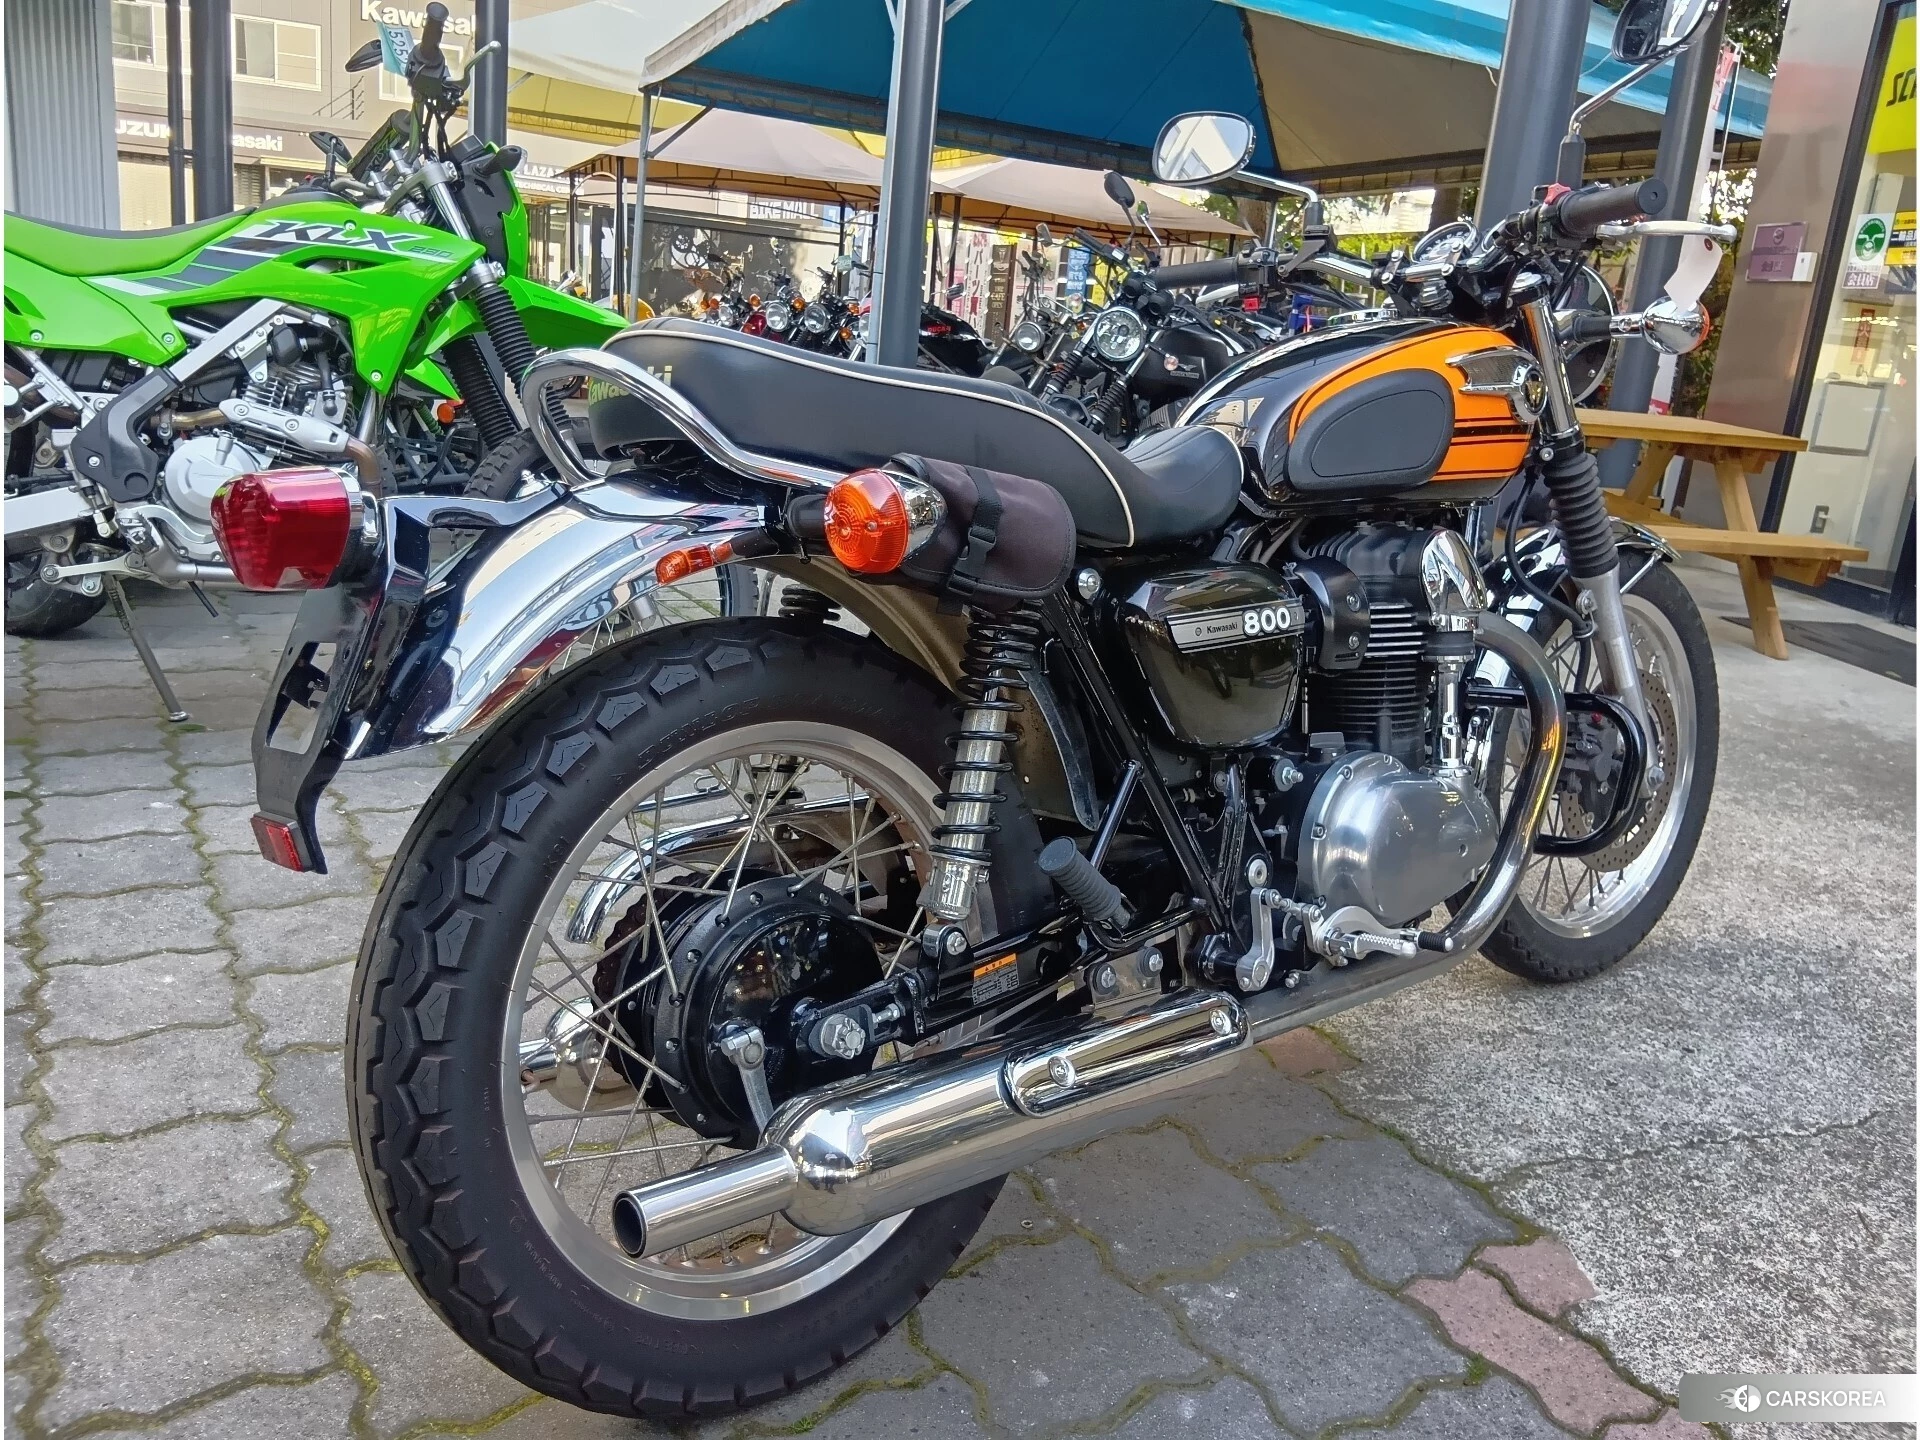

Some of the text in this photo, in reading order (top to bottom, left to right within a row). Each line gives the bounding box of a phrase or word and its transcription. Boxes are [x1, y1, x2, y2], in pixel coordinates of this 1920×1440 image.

[749, 201, 782, 219] BIKE
[783, 201, 819, 220] MALL
[262, 219, 431, 252] KLX
[1206, 606, 1291, 636] Kawasaki 800
